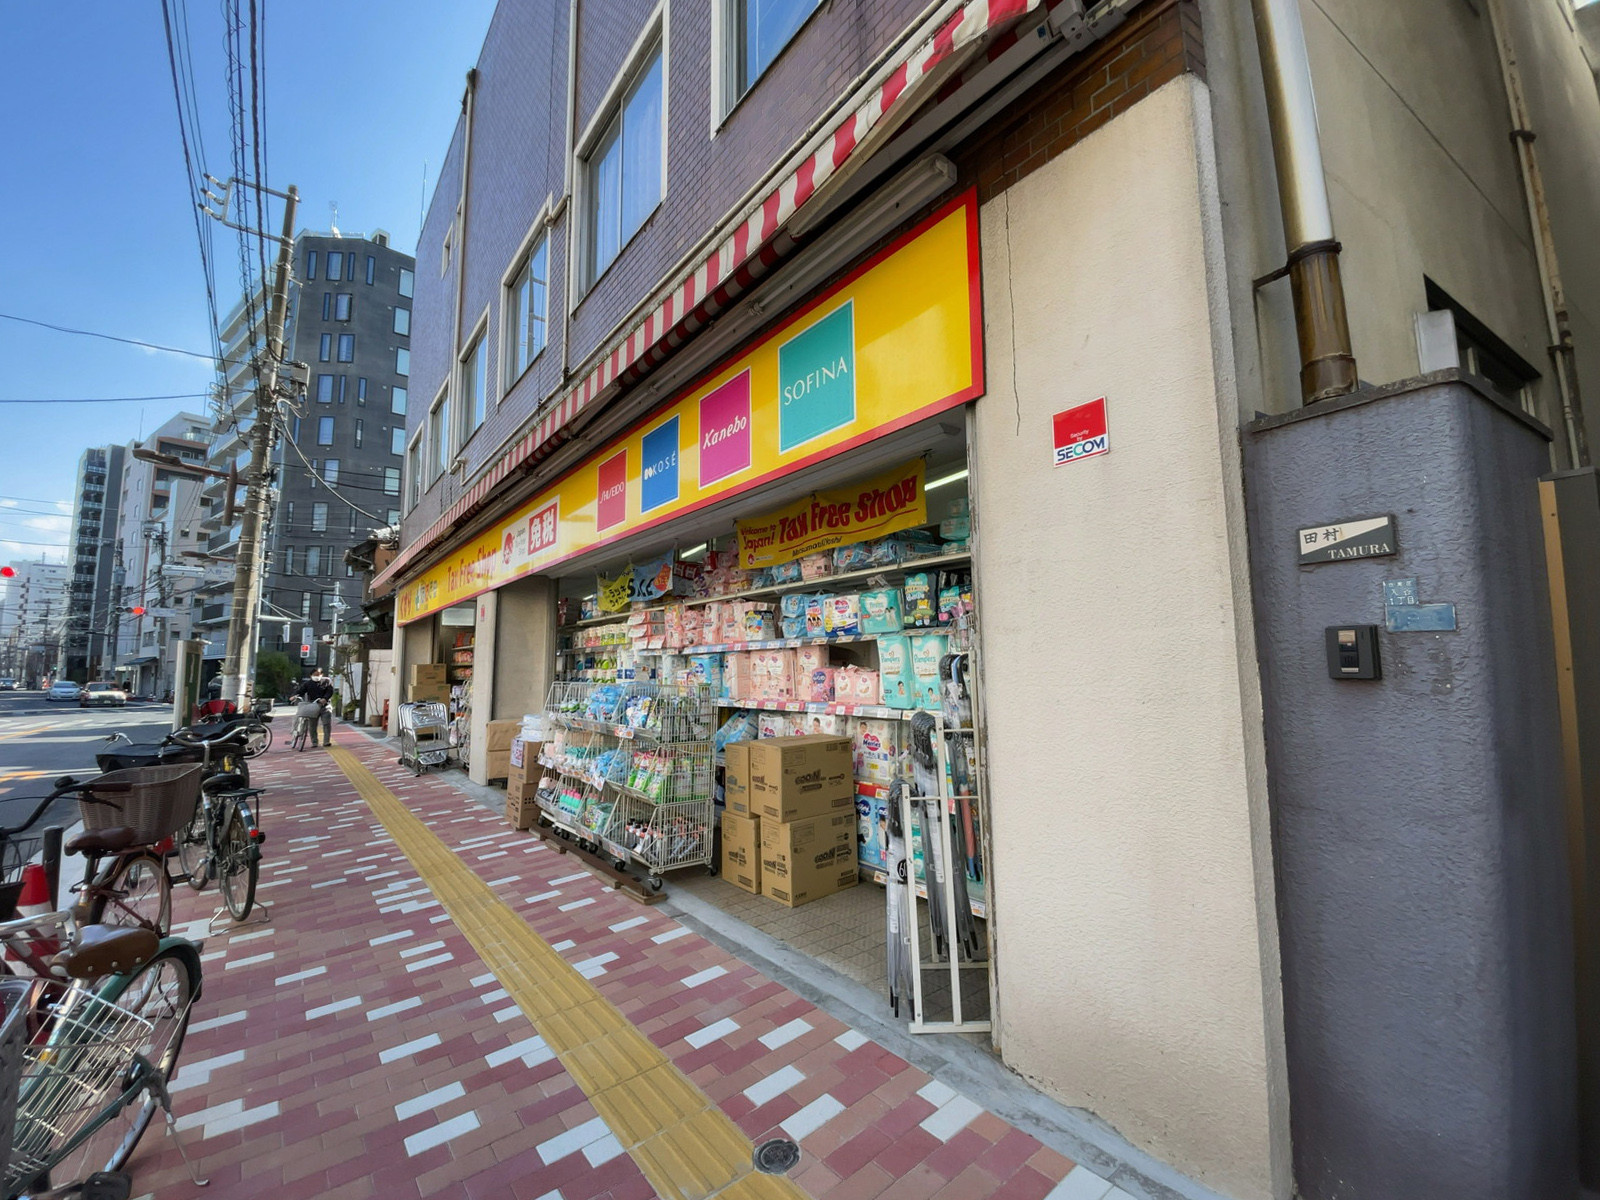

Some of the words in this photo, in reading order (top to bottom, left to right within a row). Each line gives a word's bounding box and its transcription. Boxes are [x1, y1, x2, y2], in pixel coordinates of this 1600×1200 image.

[784, 356, 848, 406] SOFINA
[702, 415, 747, 450] Kanebo
[1070, 429, 1090, 438] Security
[1057, 437, 1105, 462] SECOM
[779, 512, 809, 545] Tax
[810, 500, 852, 532] Free
[854, 474, 918, 523] Shop
[530, 508, 555, 552] 免税
[740, 526, 768, 536] Welcome
[1303, 528, 1340, 545] 田村
[743, 532, 775, 553] Japan!
[1327, 543, 1390, 560] TAMURA
